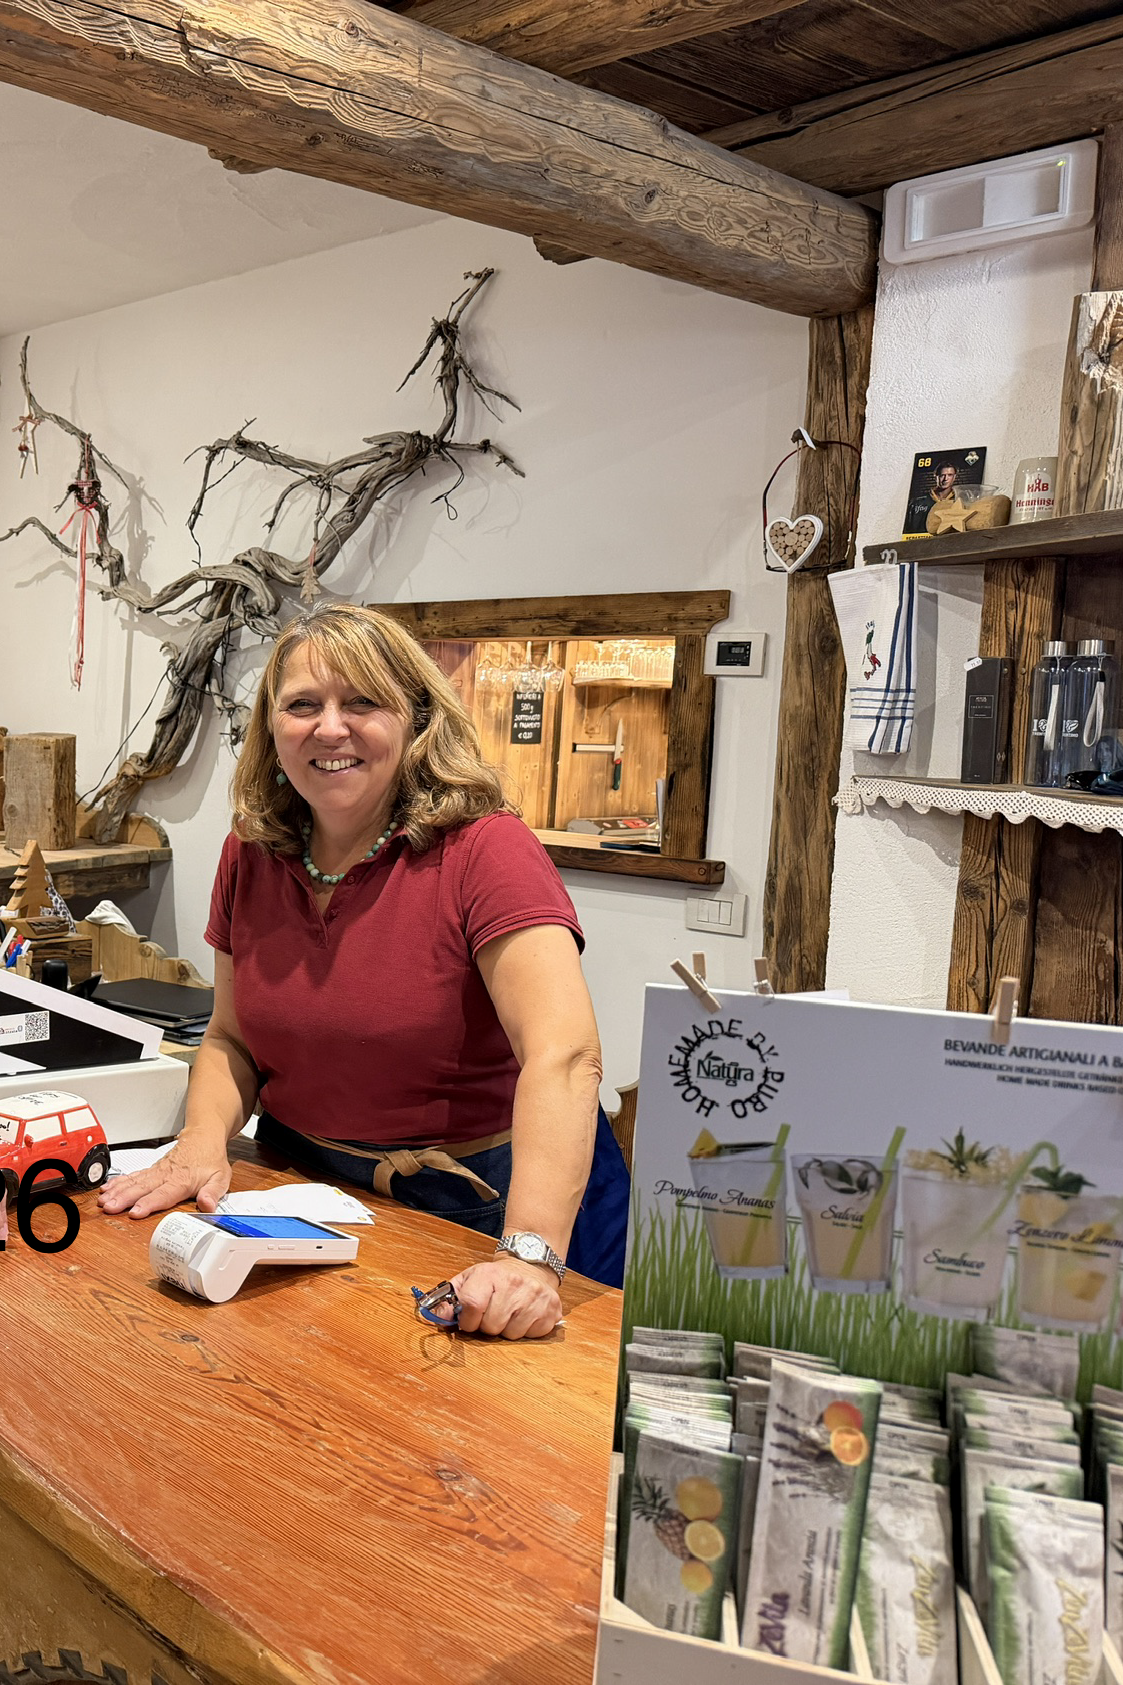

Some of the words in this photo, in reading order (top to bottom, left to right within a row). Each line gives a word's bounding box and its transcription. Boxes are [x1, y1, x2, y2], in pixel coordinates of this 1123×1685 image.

[918, 457, 932, 468] 68
[944, 1038, 1007, 1057] BEVANDE
[1008, 1046, 1095, 1065] ARTIGIANALI
[1097, 1055, 1109, 1067] A
[668, 1018, 744, 1118] HOMEMADE
[653, 1179, 718, 1201] Pompelmo
[719, 1188, 776, 1209] Ananas
[820, 1204, 864, 1222] Salvia
